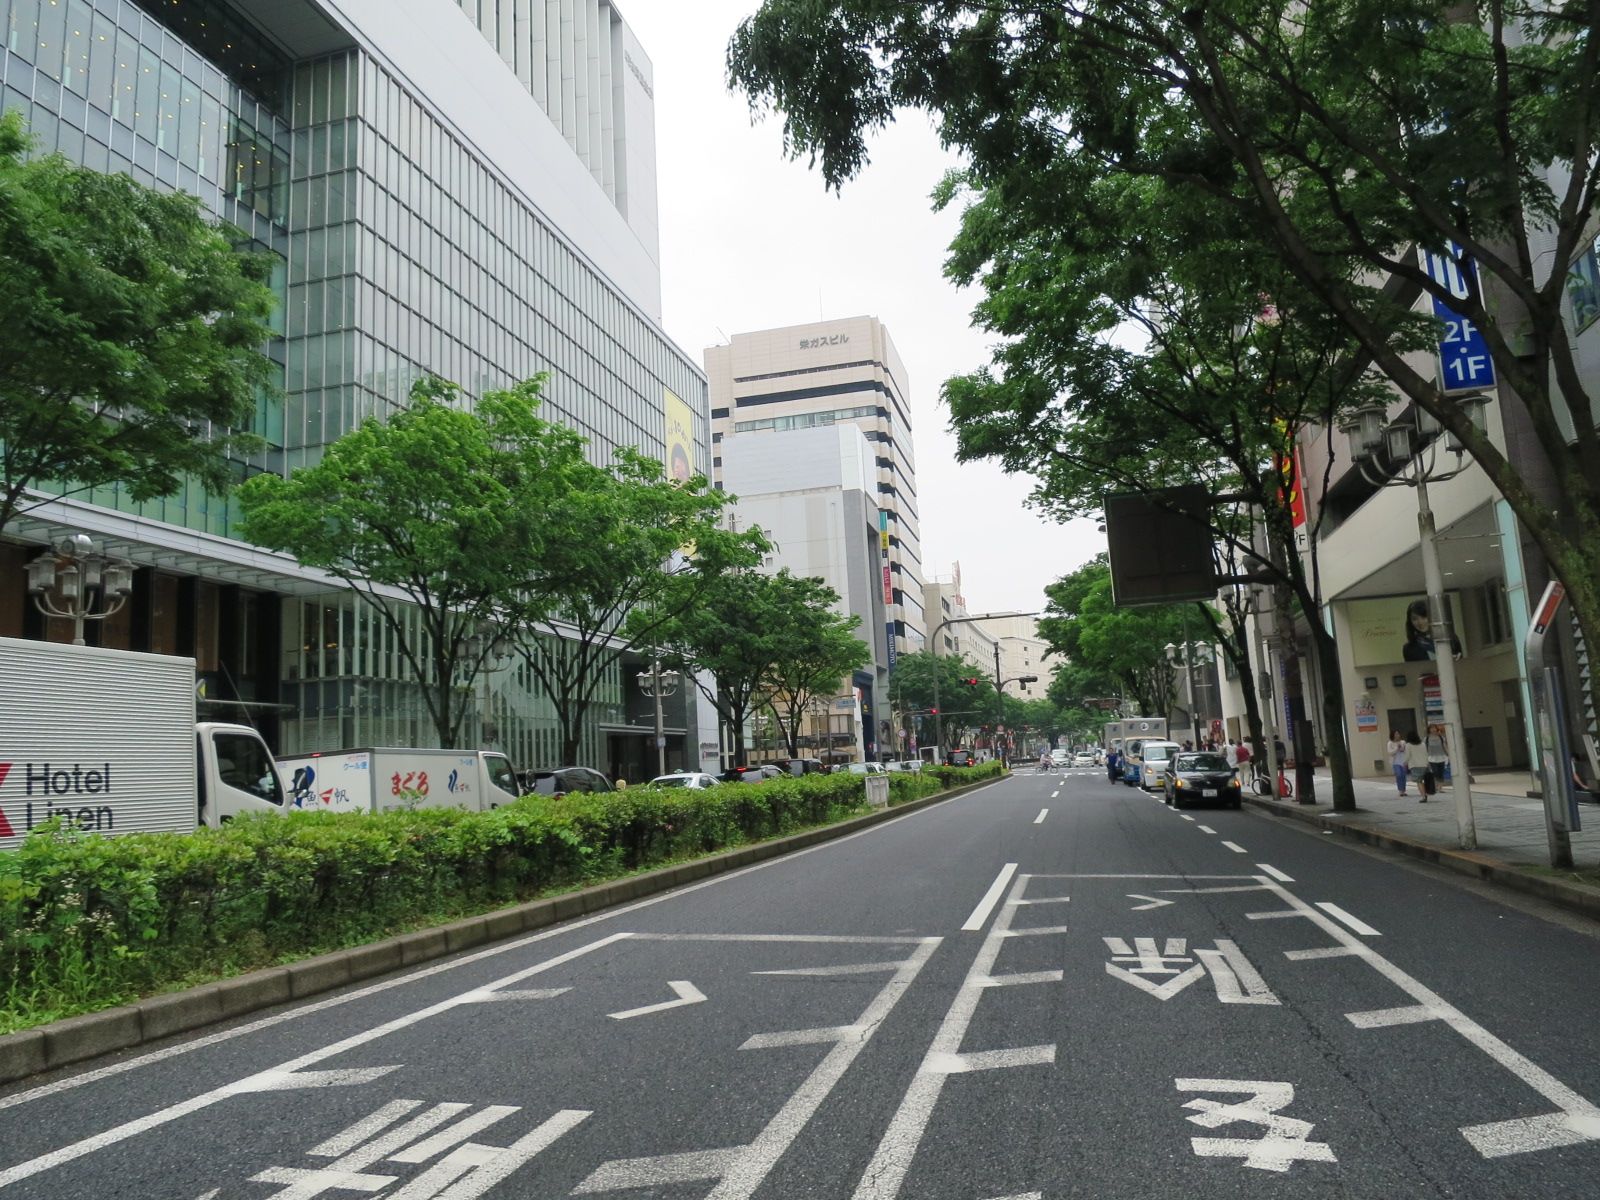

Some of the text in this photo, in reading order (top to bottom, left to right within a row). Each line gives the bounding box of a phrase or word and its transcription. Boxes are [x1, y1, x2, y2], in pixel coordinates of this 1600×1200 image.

[800, 334, 849, 350] 栄ガスビル
[1445, 319, 1477, 342] 2F
[1450, 356, 1485, 380] 1F
[888, 633, 896, 664] MIKIMOTO
[26, 763, 110, 795] Hotel
